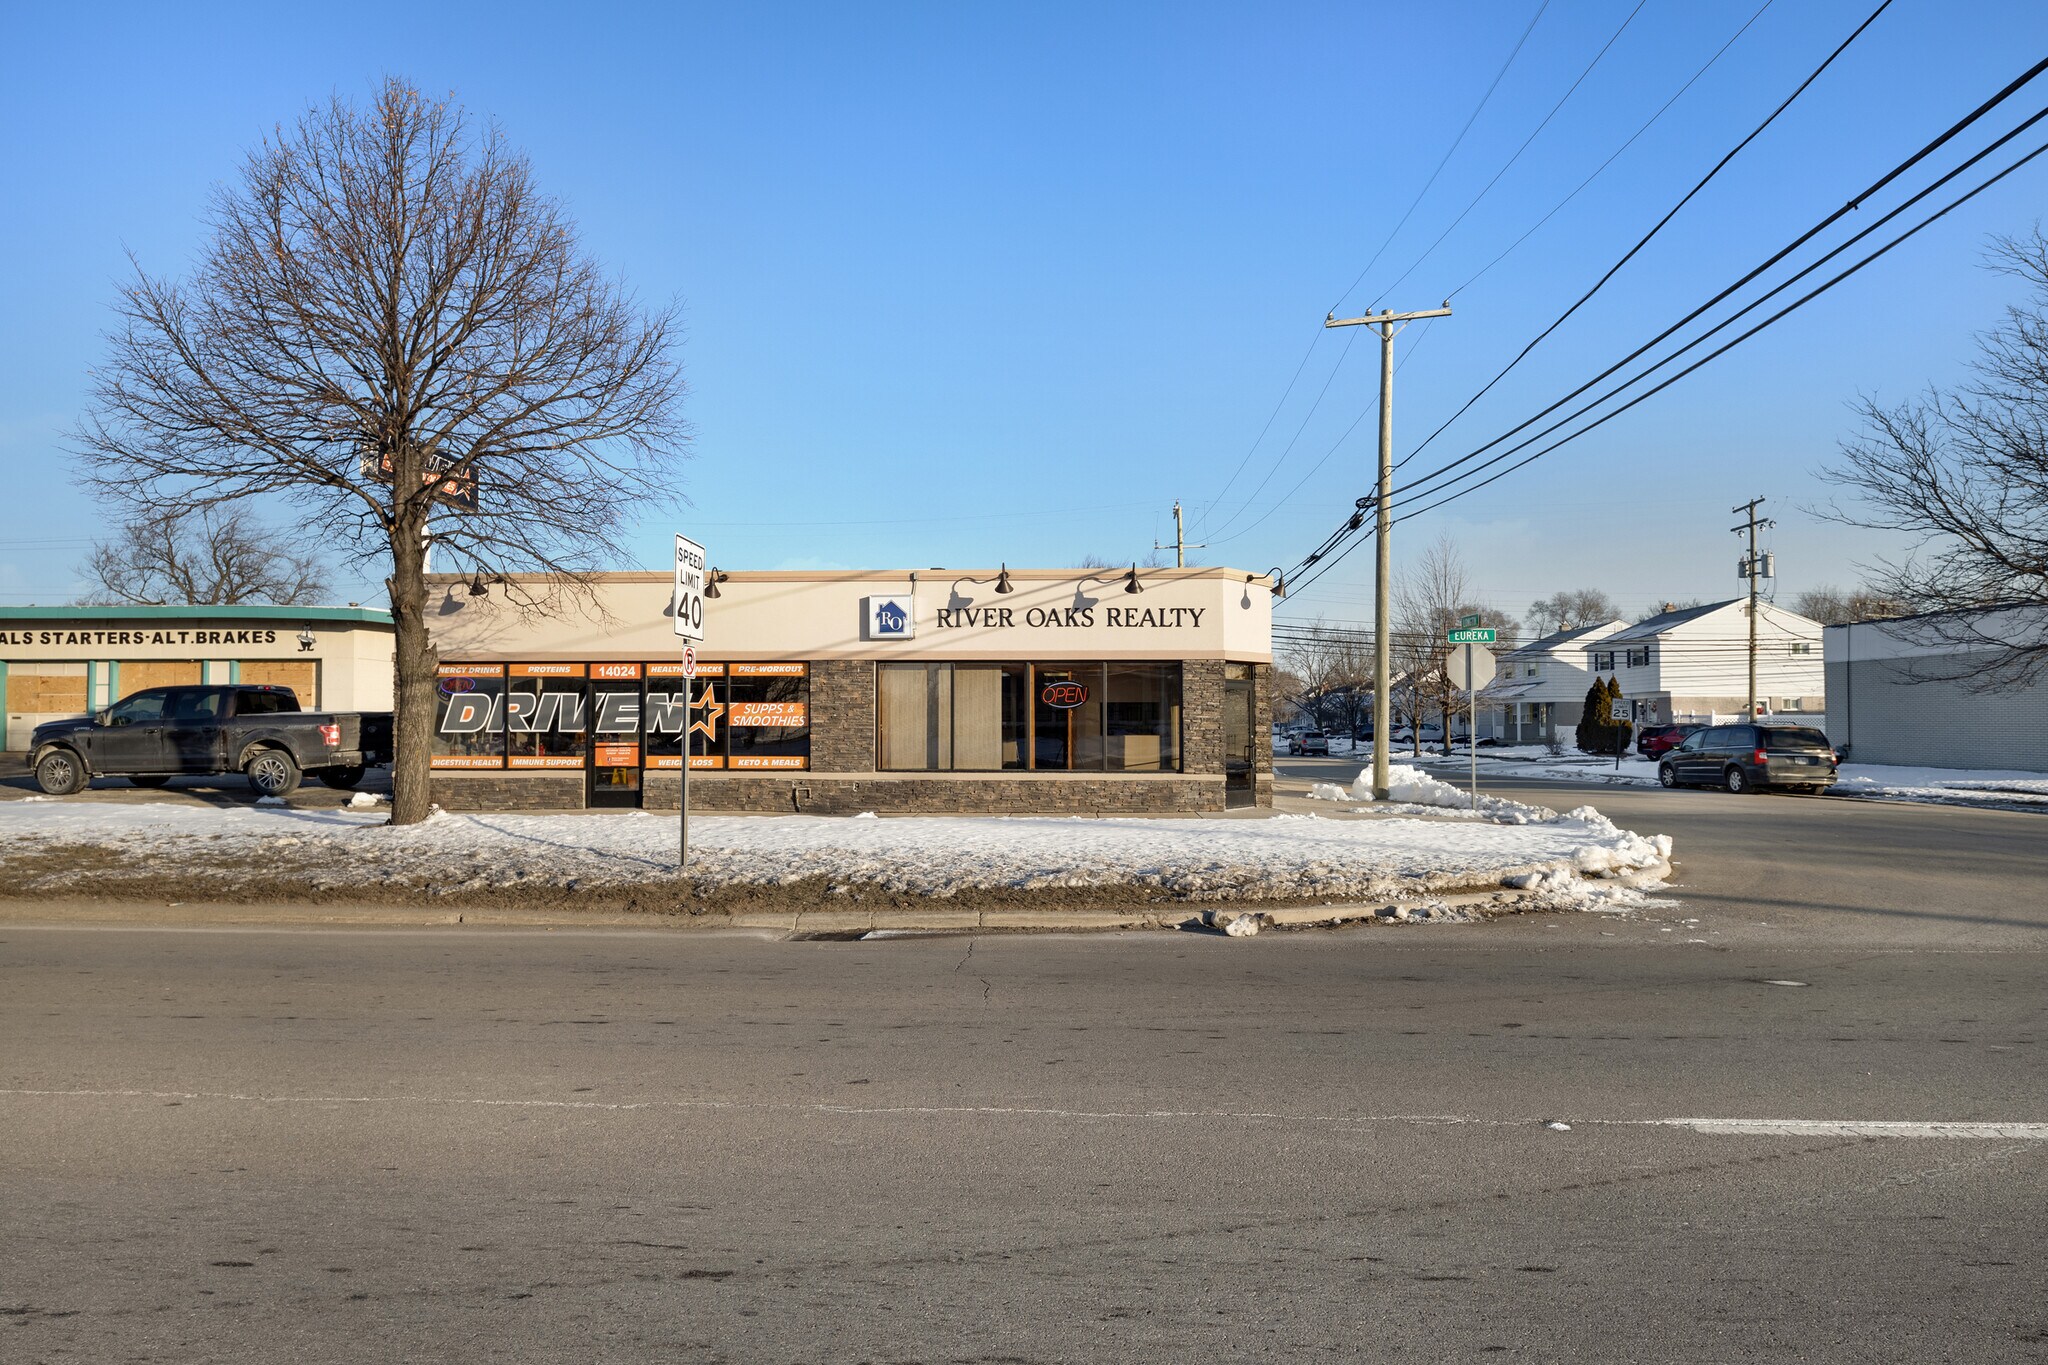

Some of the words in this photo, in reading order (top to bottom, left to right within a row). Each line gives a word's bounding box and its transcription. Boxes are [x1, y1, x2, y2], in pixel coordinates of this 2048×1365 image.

[678, 547, 703, 571] SPEED
[680, 569, 700, 590] LIMIT
[677, 592, 702, 629] 40
[881, 611, 902, 631] RO
[936, 608, 1016, 629] RIVER
[1026, 607, 1095, 628] OAKS
[1106, 608, 1206, 628] REALTY
[0, 631, 33, 645] ALS
[1454, 631, 1489, 641] EUREKA
[437, 666, 467, 674] NERGY
[468, 666, 501, 674] DRINKS
[599, 666, 636, 677] 14024
[738, 665, 803, 673] PRE-WORKOUT
[1042, 687, 1088, 704] OPEN
[440, 692, 694, 733] DRIVEN
[743, 703, 784, 714] SUPPS
[788, 704, 795, 713] &
[1613, 709, 1629, 718] 25
[732, 715, 806, 727] SMOOTHIES
[471, 759, 502, 767] HEALTH
